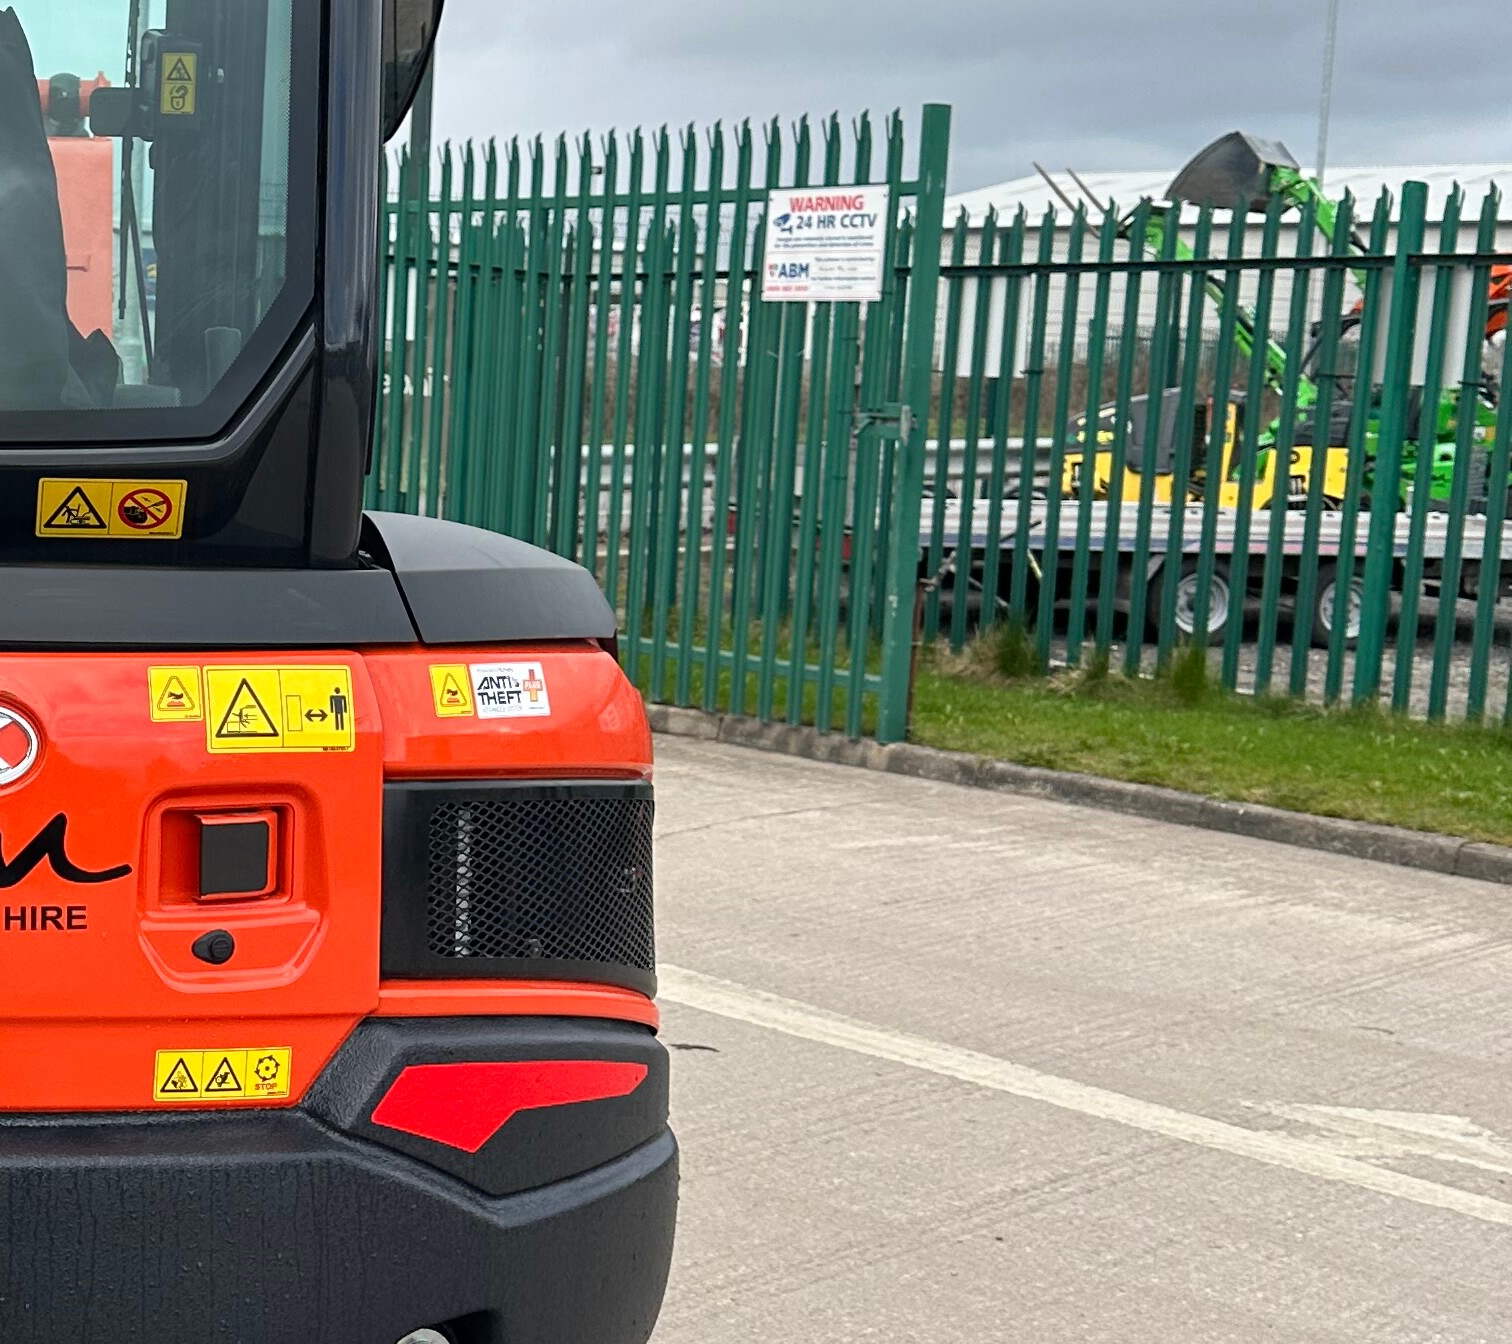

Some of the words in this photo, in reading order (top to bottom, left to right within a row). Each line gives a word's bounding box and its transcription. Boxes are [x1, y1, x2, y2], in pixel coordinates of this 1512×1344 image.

[789, 195, 864, 213] WARNING
[796, 216, 813, 229] 24
[817, 215, 836, 229] HR
[840, 213, 878, 229] CCTV
[778, 263, 809, 278] ABM
[477, 675, 512, 690] ANTI
[477, 691, 522, 705] THEFT
[5, 906, 87, 931] HIRE
